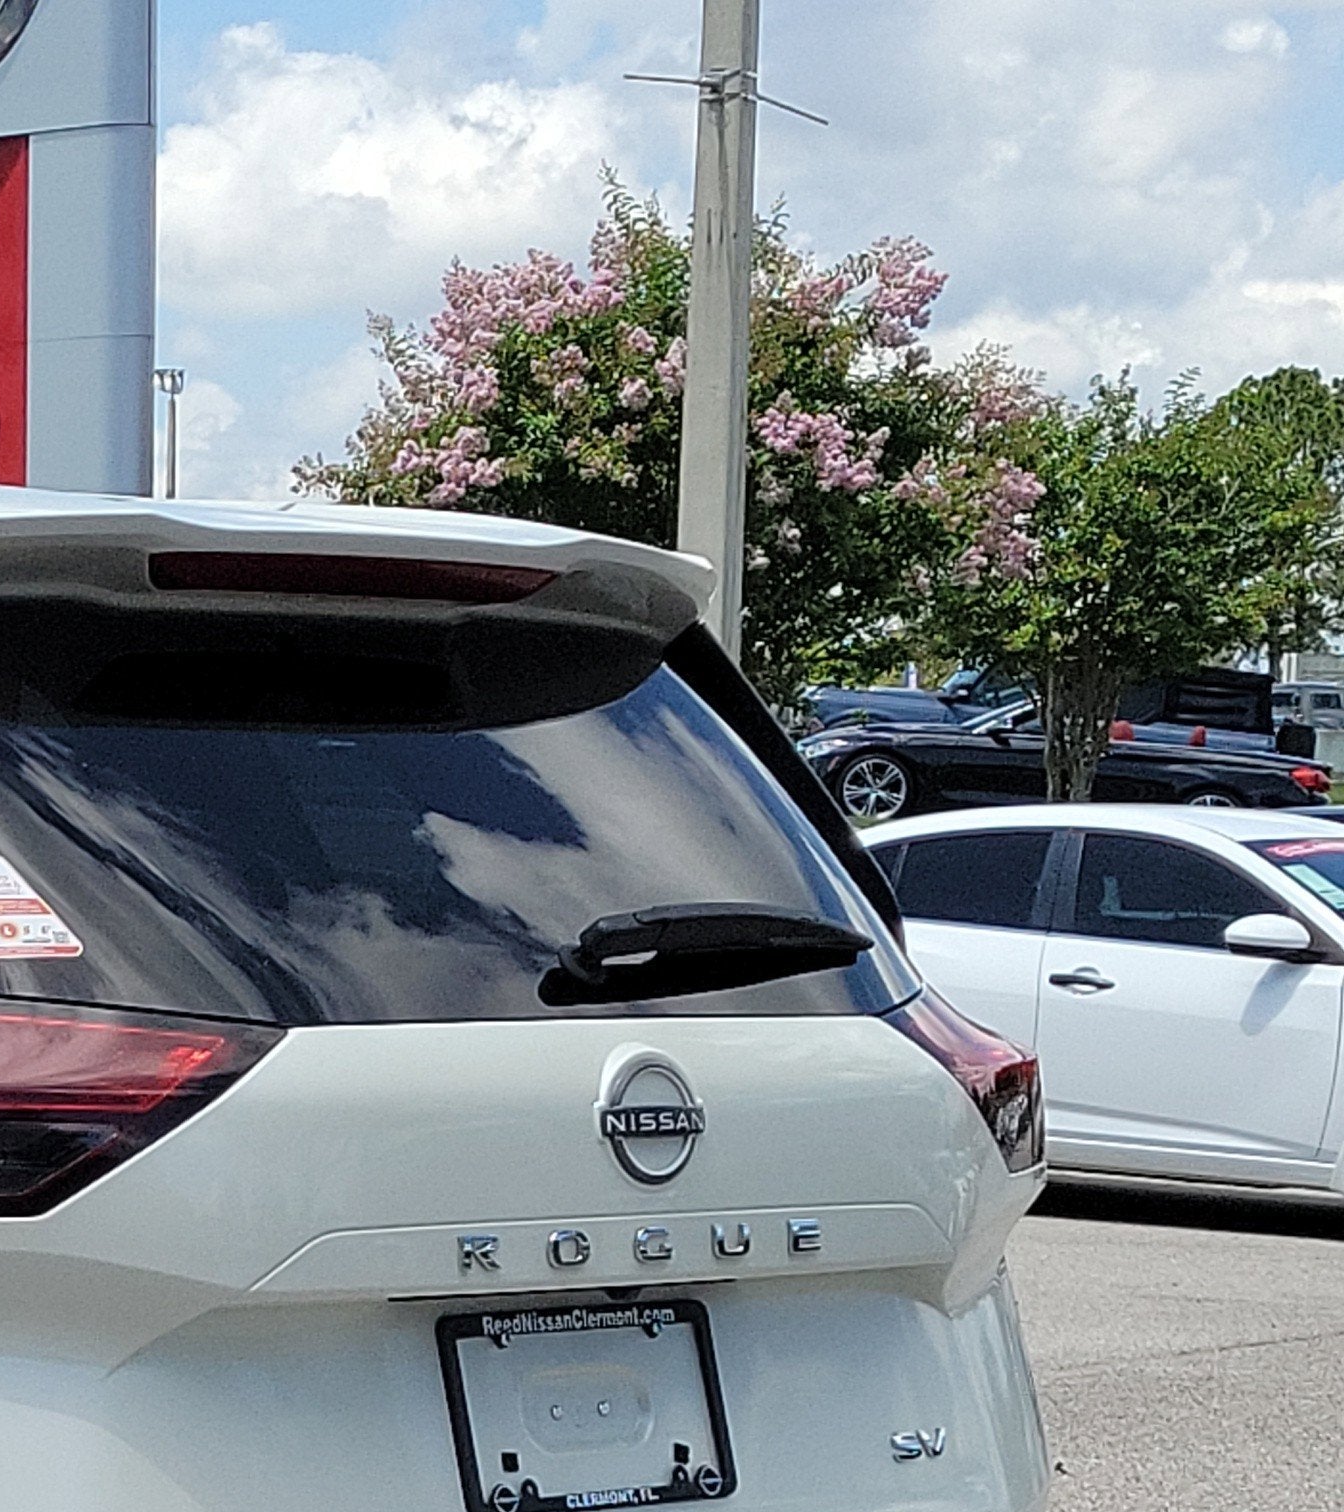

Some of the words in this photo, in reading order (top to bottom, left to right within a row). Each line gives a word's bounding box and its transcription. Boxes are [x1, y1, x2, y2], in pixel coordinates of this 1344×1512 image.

[606, 1110, 706, 1134] NISSAN
[457, 1217, 823, 1275] ROGUE
[481, 1306, 676, 1336] ReedNissanClermont.com
[890, 1427, 946, 1463] SV
